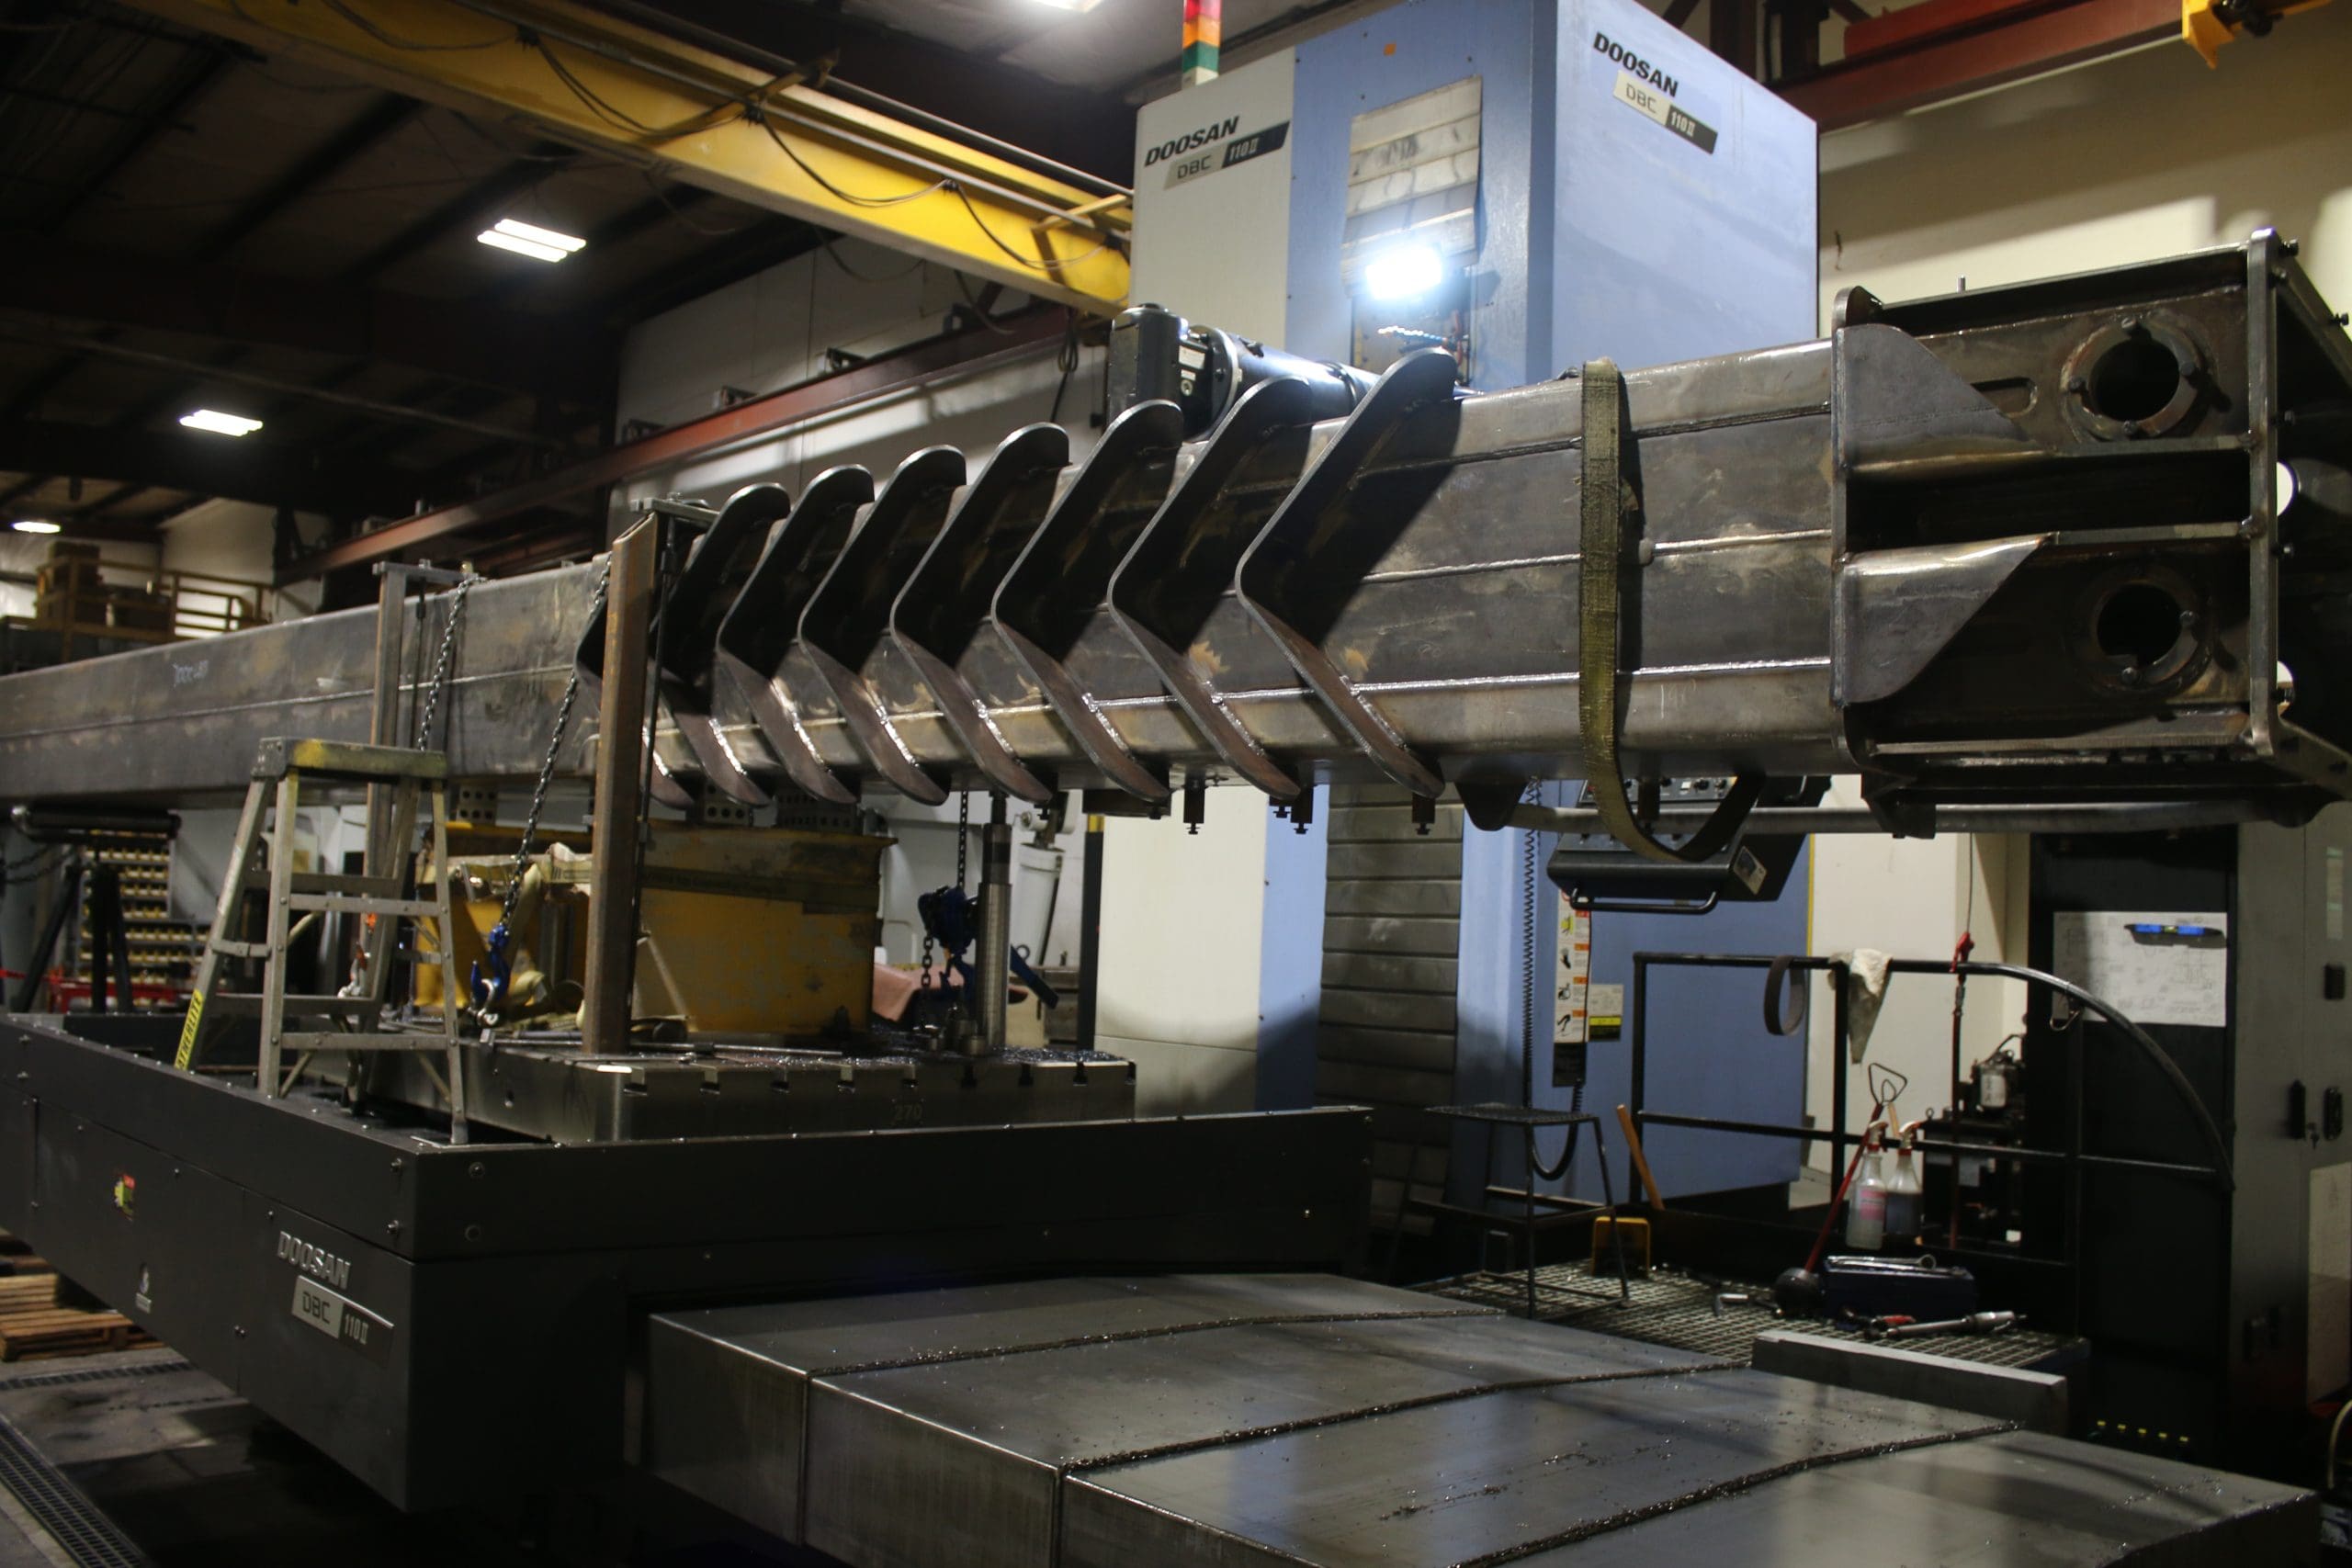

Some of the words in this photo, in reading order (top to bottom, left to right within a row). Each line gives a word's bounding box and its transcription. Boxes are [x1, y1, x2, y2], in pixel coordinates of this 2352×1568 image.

[1593, 31, 1679, 97] DOOSAN
[1625, 84, 1657, 114] DBC
[1144, 115, 1239, 167] DOOSAN
[1177, 154, 1212, 179] DBC
[277, 1230, 351, 1291] DOOSAN
[301, 1291, 331, 1325] DBC
